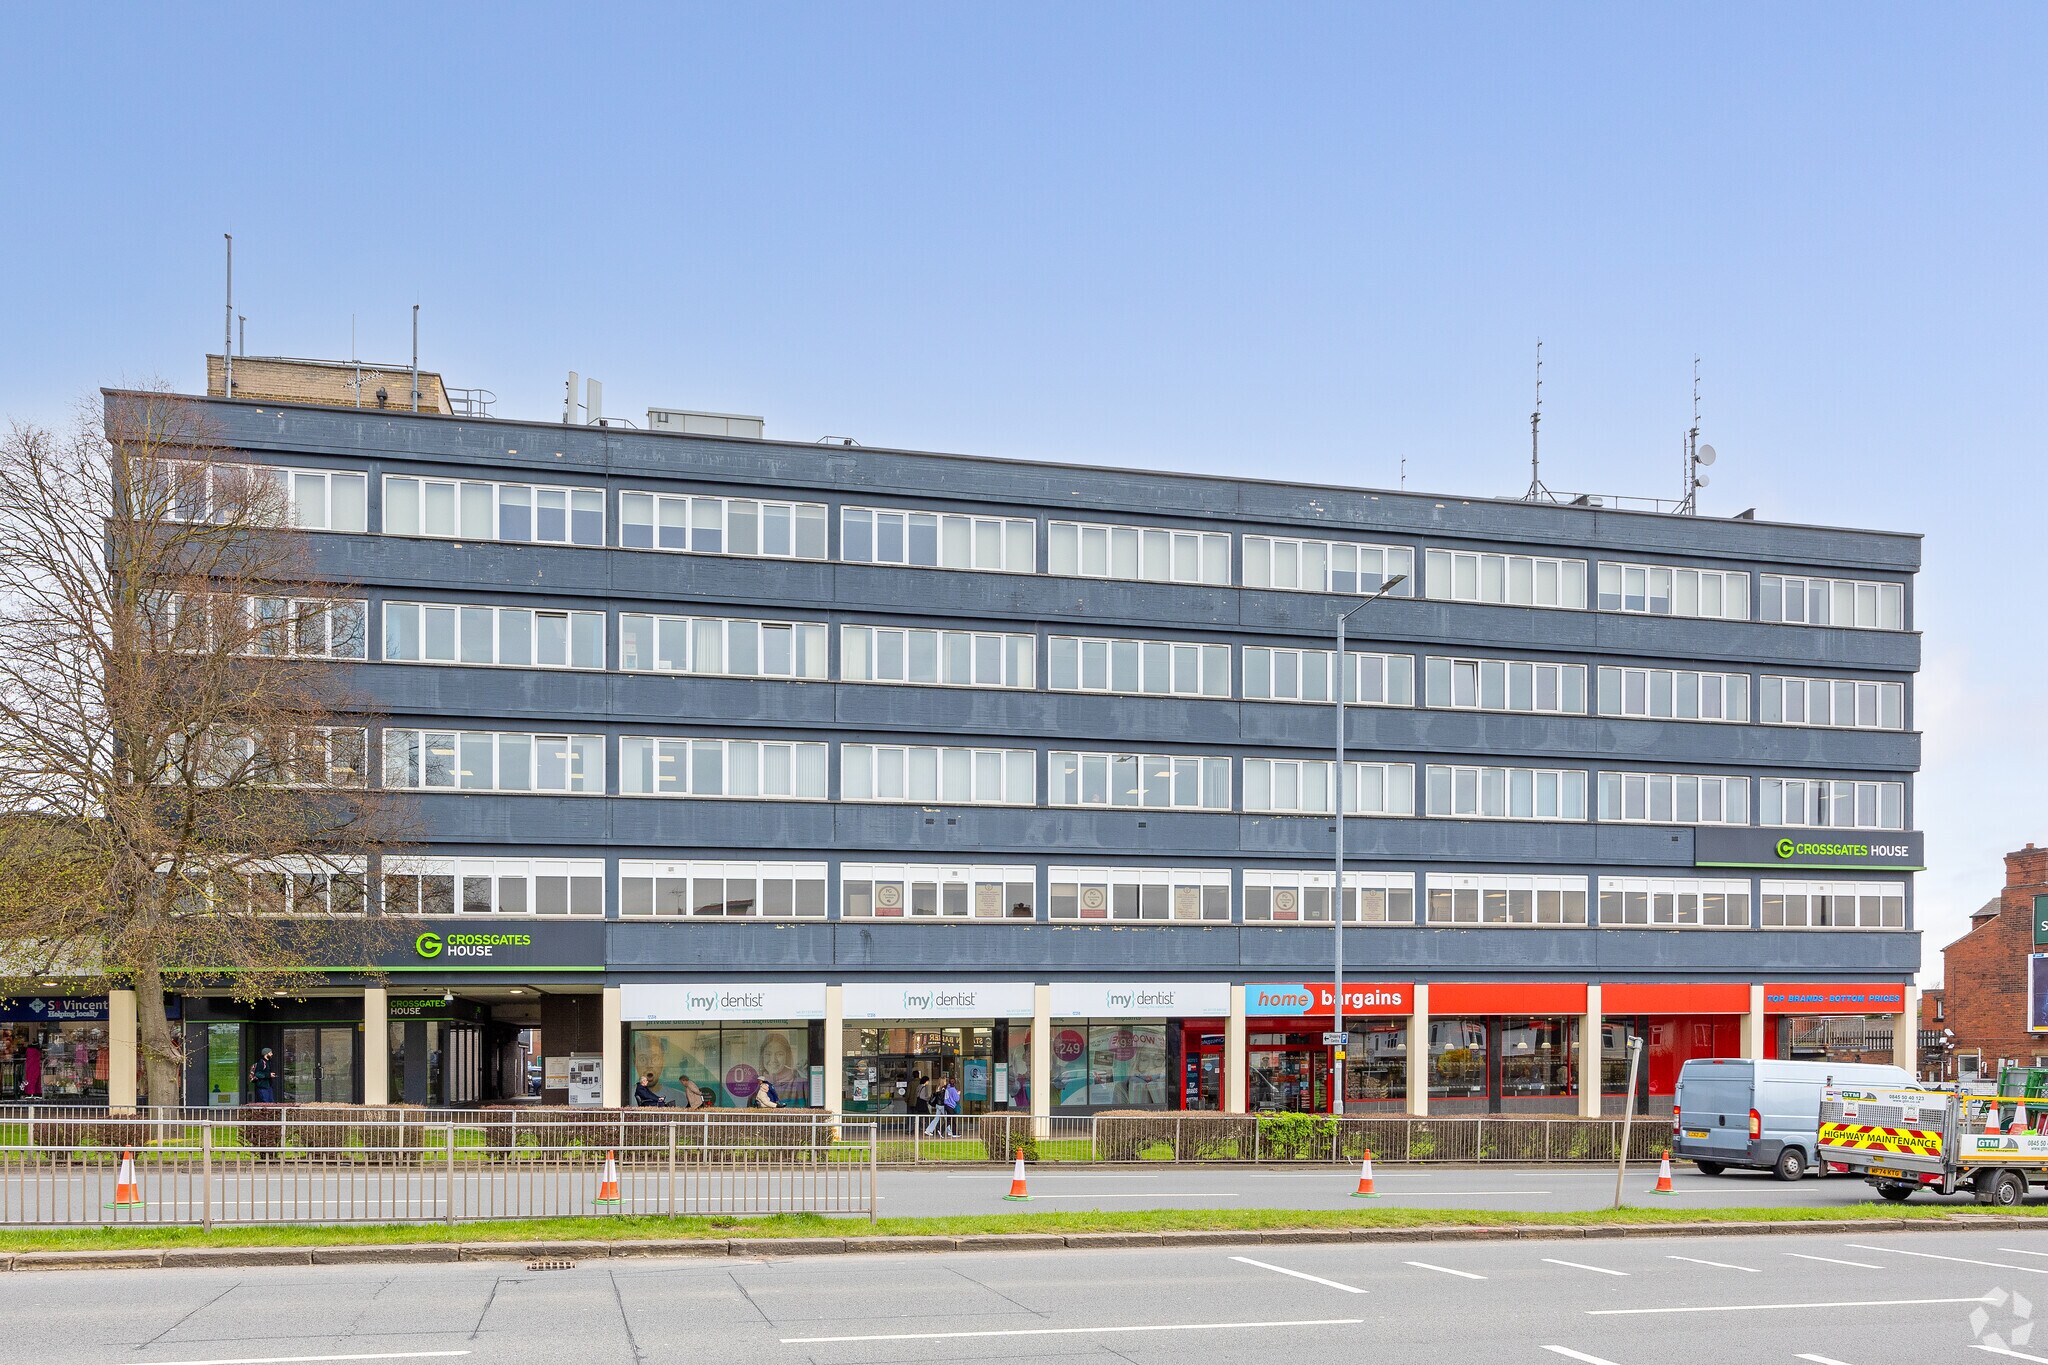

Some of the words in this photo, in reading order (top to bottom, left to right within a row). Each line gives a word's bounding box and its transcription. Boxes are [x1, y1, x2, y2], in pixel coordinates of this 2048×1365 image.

[1796, 843, 1868, 856] CROSSGATES
[1871, 845, 1909, 857] HOUSE
[447, 934, 531, 946] CROSSGATES
[447, 945, 493, 956] HOUSE
[721, 992, 764, 1008] dentist
[935, 991, 976, 1006] dentist
[1137, 990, 1175, 1005] dentist
[1258, 992, 1309, 1006] home
[76, 1010, 99, 1018] locally
[1824, 1130, 1865, 1142] HIGHWAY
[1867, 1134, 1937, 1148] MAINTENANCE
[1978, 1139, 1999, 1147] GTM
